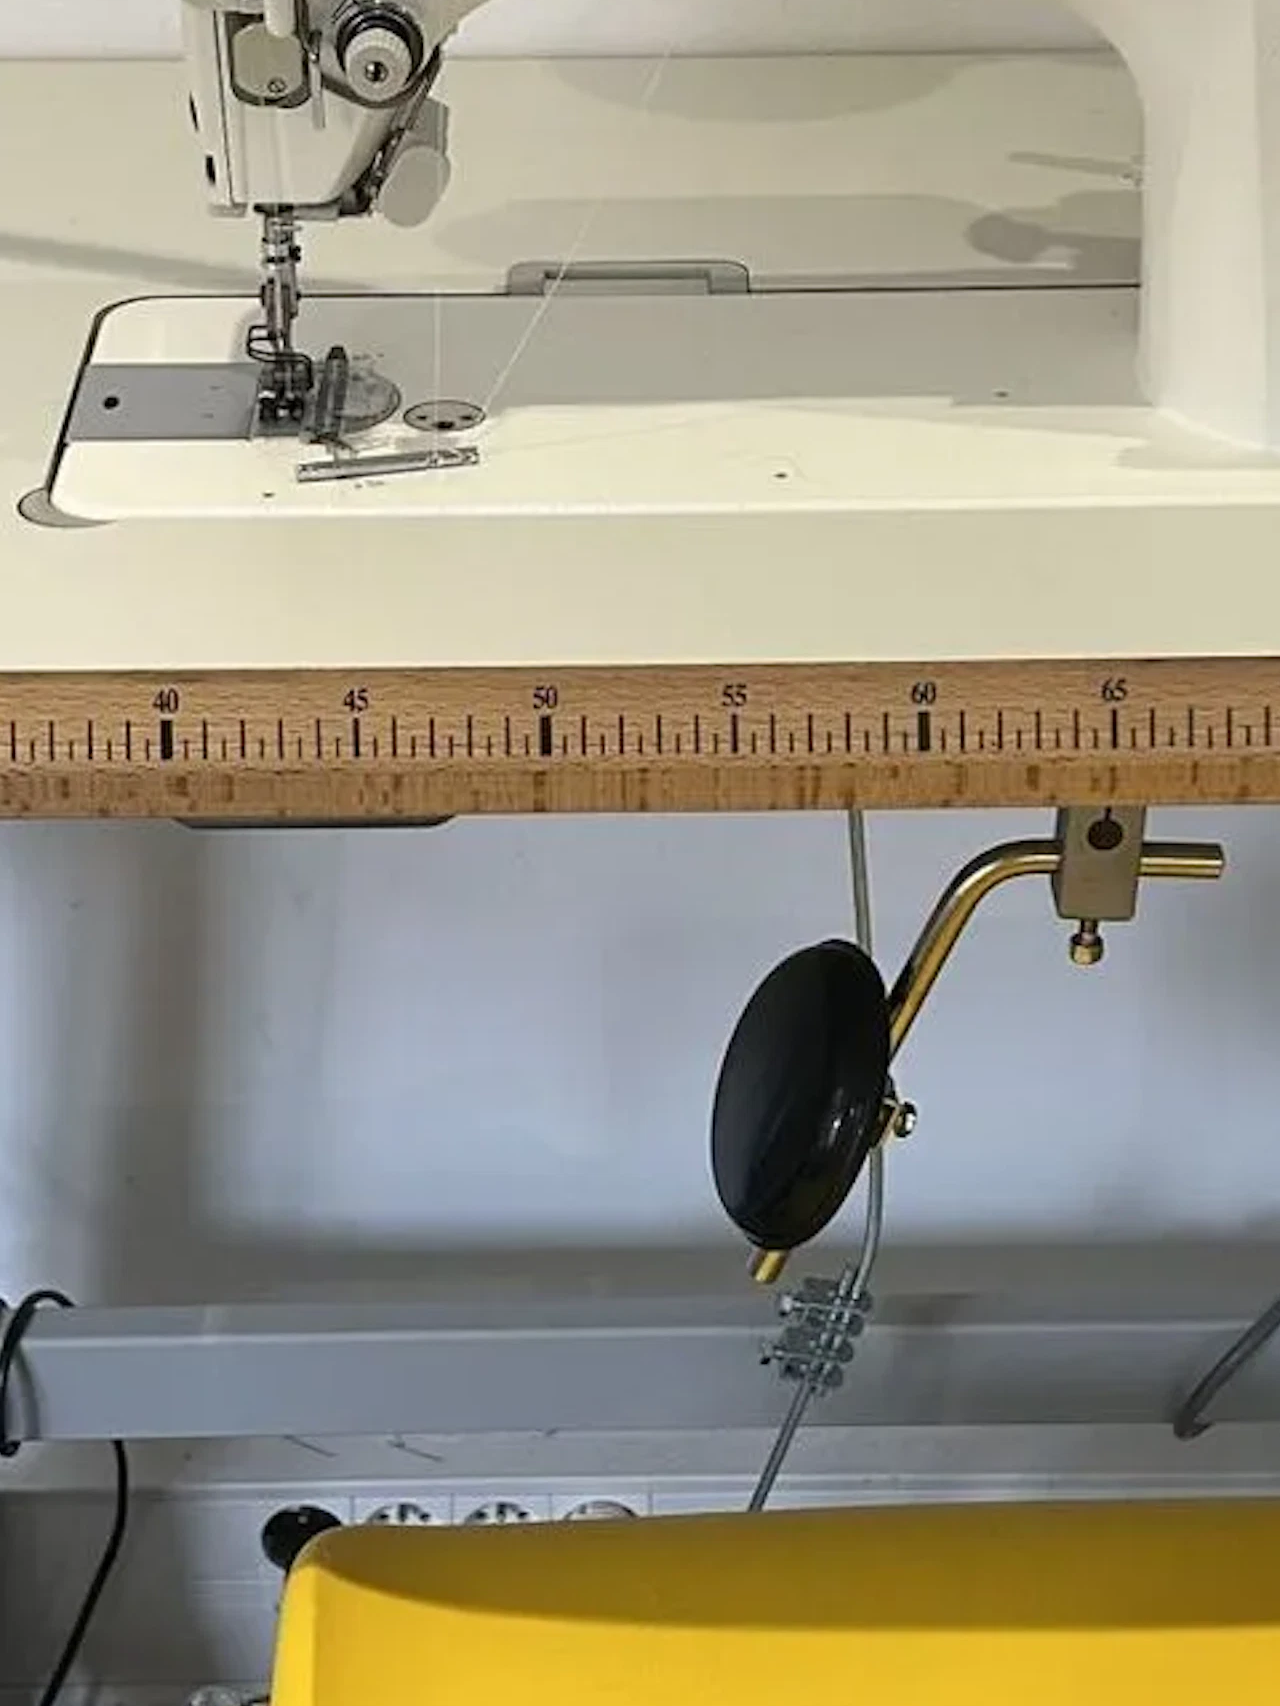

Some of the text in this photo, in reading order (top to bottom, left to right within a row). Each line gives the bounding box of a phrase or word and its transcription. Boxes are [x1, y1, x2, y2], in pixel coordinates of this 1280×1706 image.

[152, 688, 179, 713] 40
[343, 688, 368, 713] 45
[533, 686, 558, 709] 50
[722, 683, 747, 707] 55
[911, 682, 936, 705] 60
[1101, 678, 1128, 703] 65
